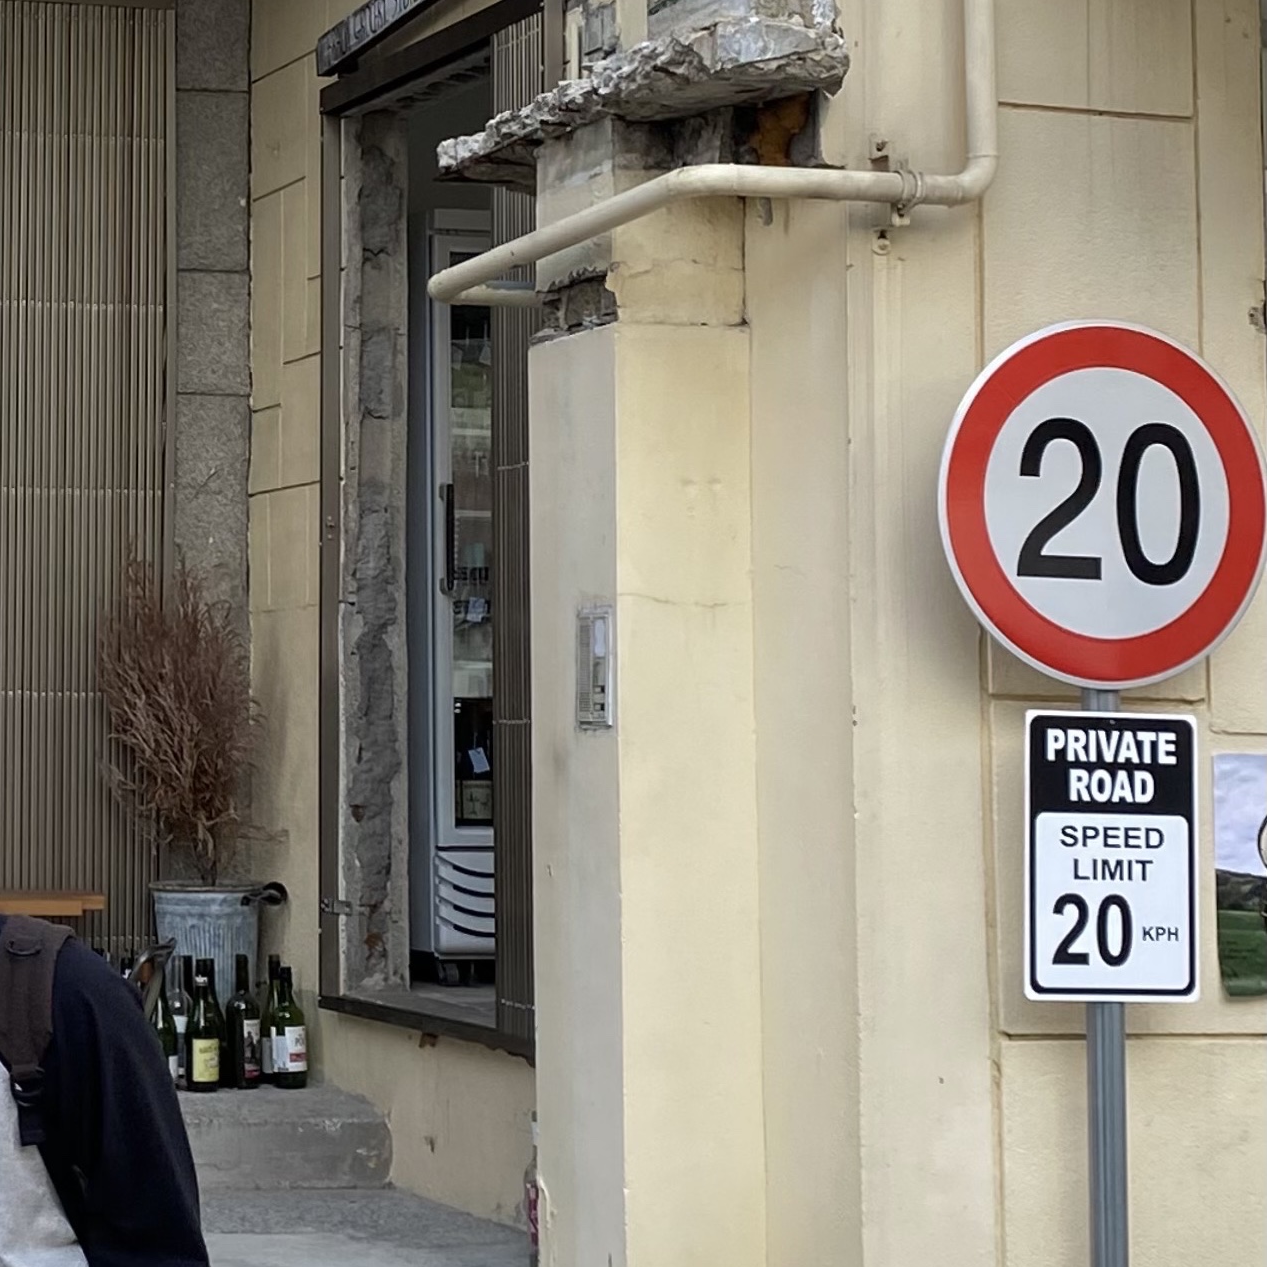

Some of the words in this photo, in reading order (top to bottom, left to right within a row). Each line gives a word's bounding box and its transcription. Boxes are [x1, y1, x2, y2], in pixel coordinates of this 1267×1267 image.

[1017, 416, 1201, 586] 20
[1045, 728, 1177, 765] PRIVATE
[1068, 768, 1155, 803] ROAD
[1059, 825, 1165, 849] SPEED
[1073, 858, 1154, 881] LIMIT
[1051, 893, 1133, 967] 20
[1142, 926, 1180, 942] KPH
